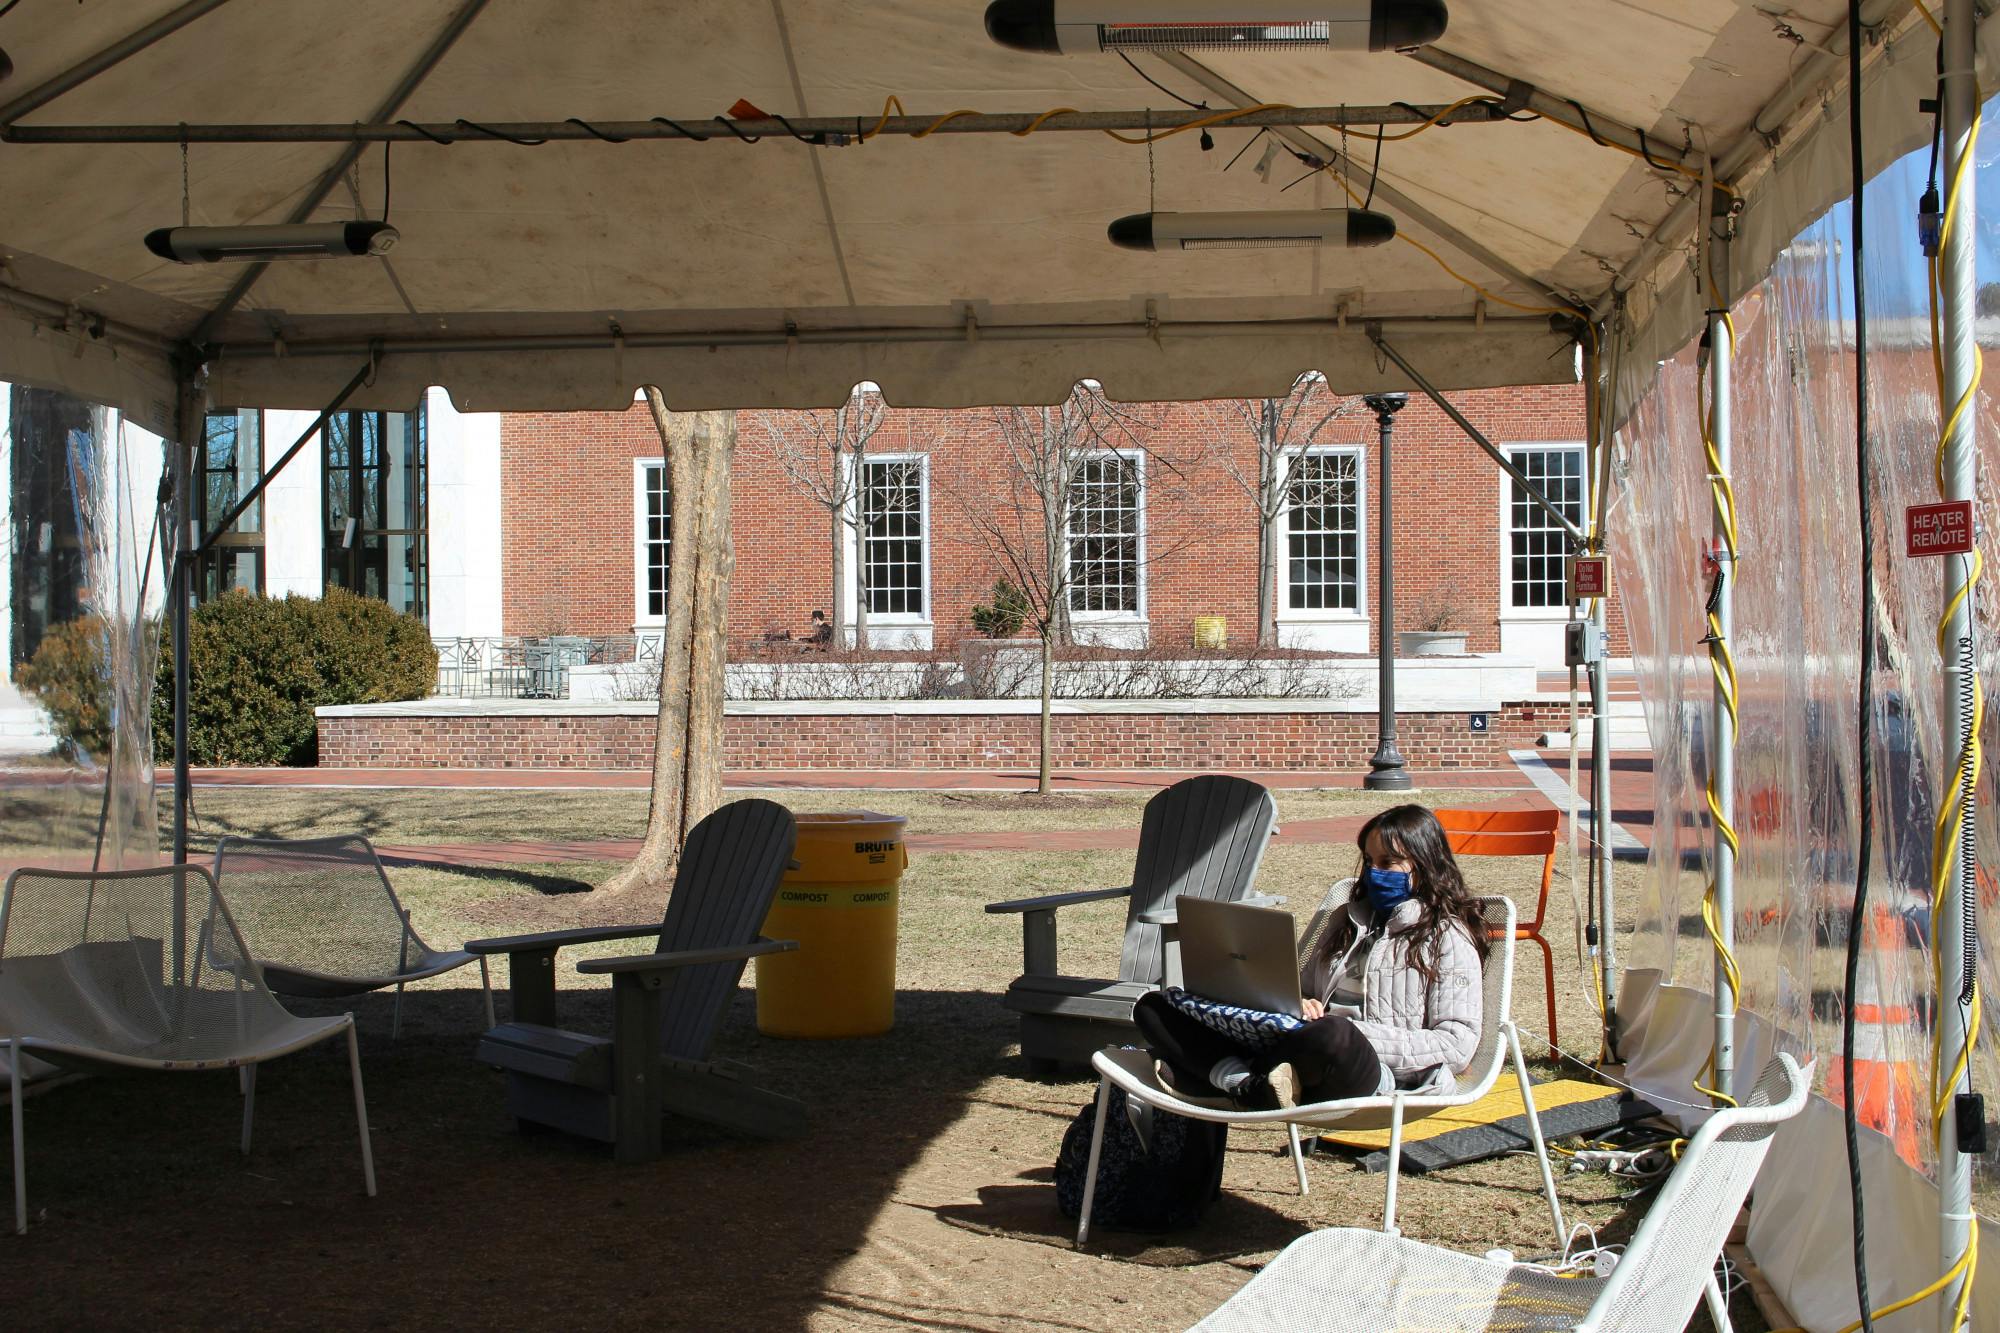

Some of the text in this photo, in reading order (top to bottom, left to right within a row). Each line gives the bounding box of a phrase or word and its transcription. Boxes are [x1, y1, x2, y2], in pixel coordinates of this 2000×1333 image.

[1913, 511, 1965, 529] HEATER
[1912, 529, 1966, 547] REMOTE
[855, 841, 896, 853] BRUTE
[782, 892, 829, 902] COMPOST
[853, 892, 890, 902] COMPOST
